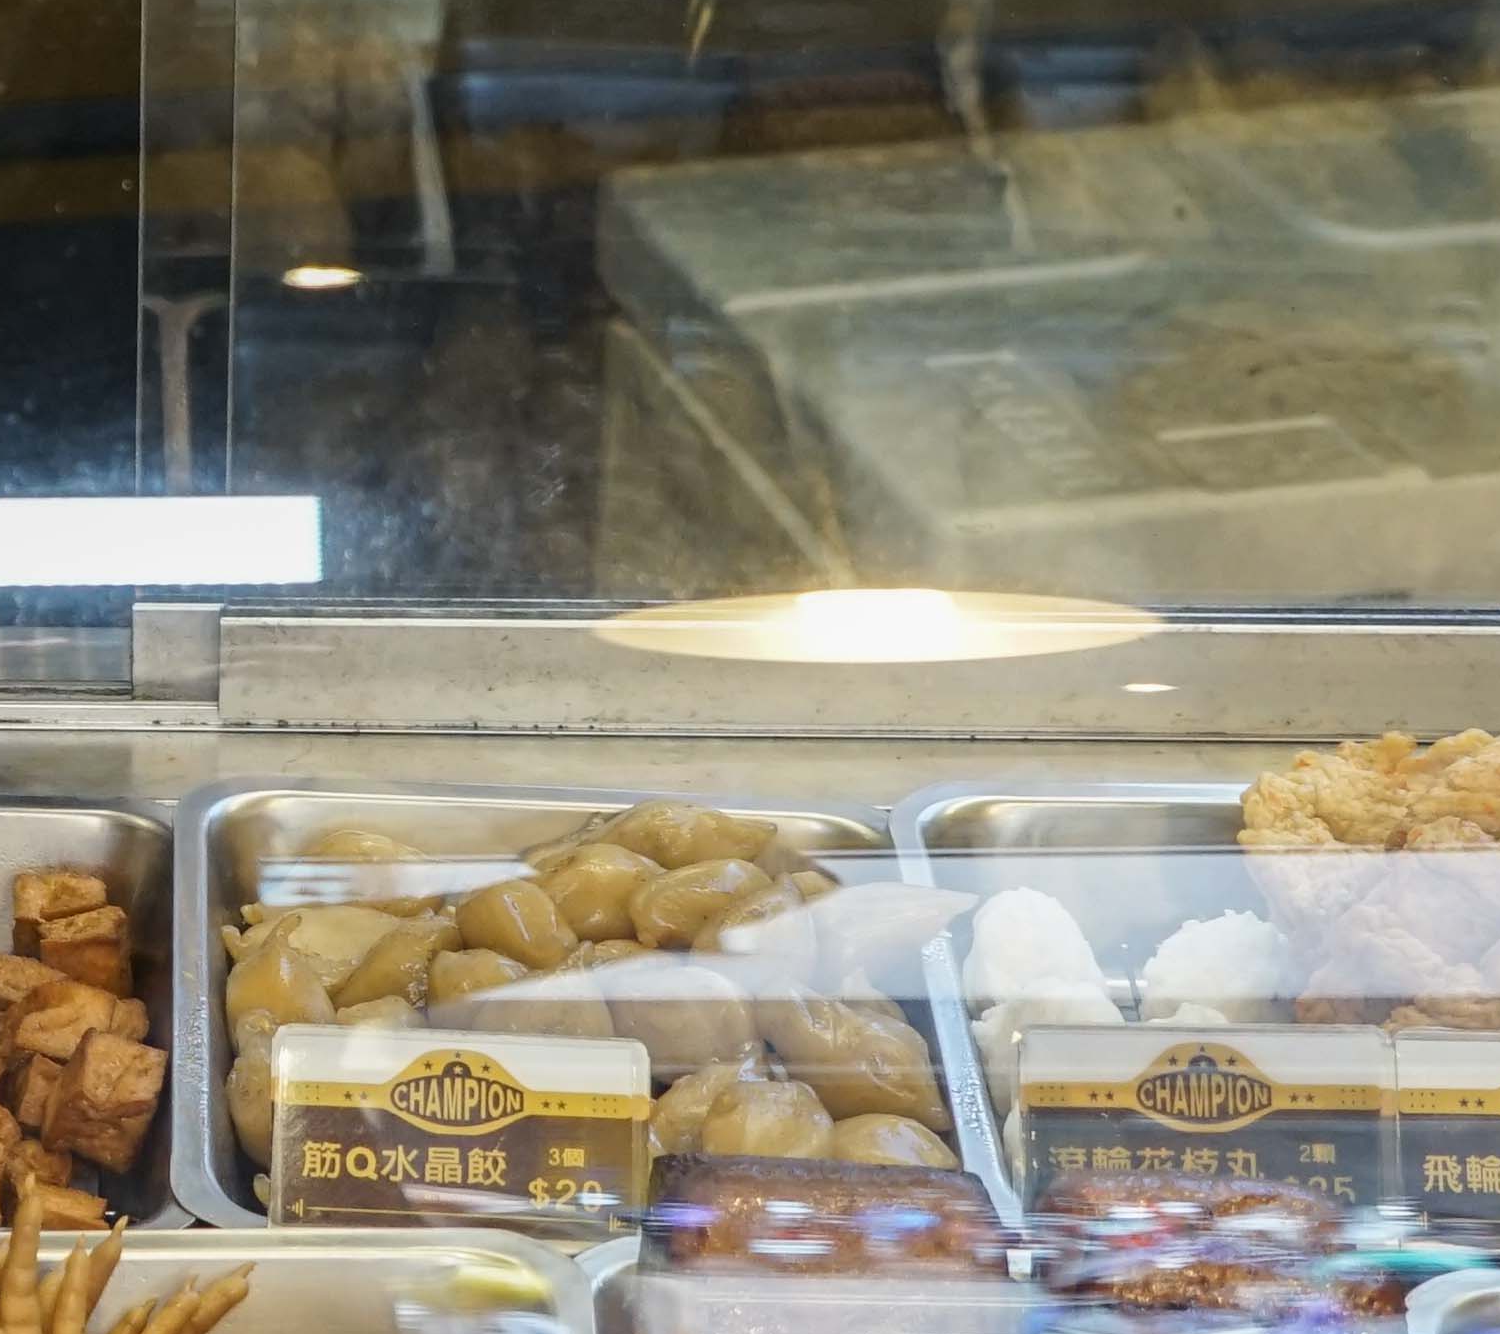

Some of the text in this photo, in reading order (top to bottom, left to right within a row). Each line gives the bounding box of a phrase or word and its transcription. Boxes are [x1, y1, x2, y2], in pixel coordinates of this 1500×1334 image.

[392, 1077, 523, 1121] CHAMPION
[1140, 1070, 1271, 1119] CHAMPION
[302, 1140, 508, 1187] 筋Q水晶餃
[1286, 1176, 1355, 1201] 25
